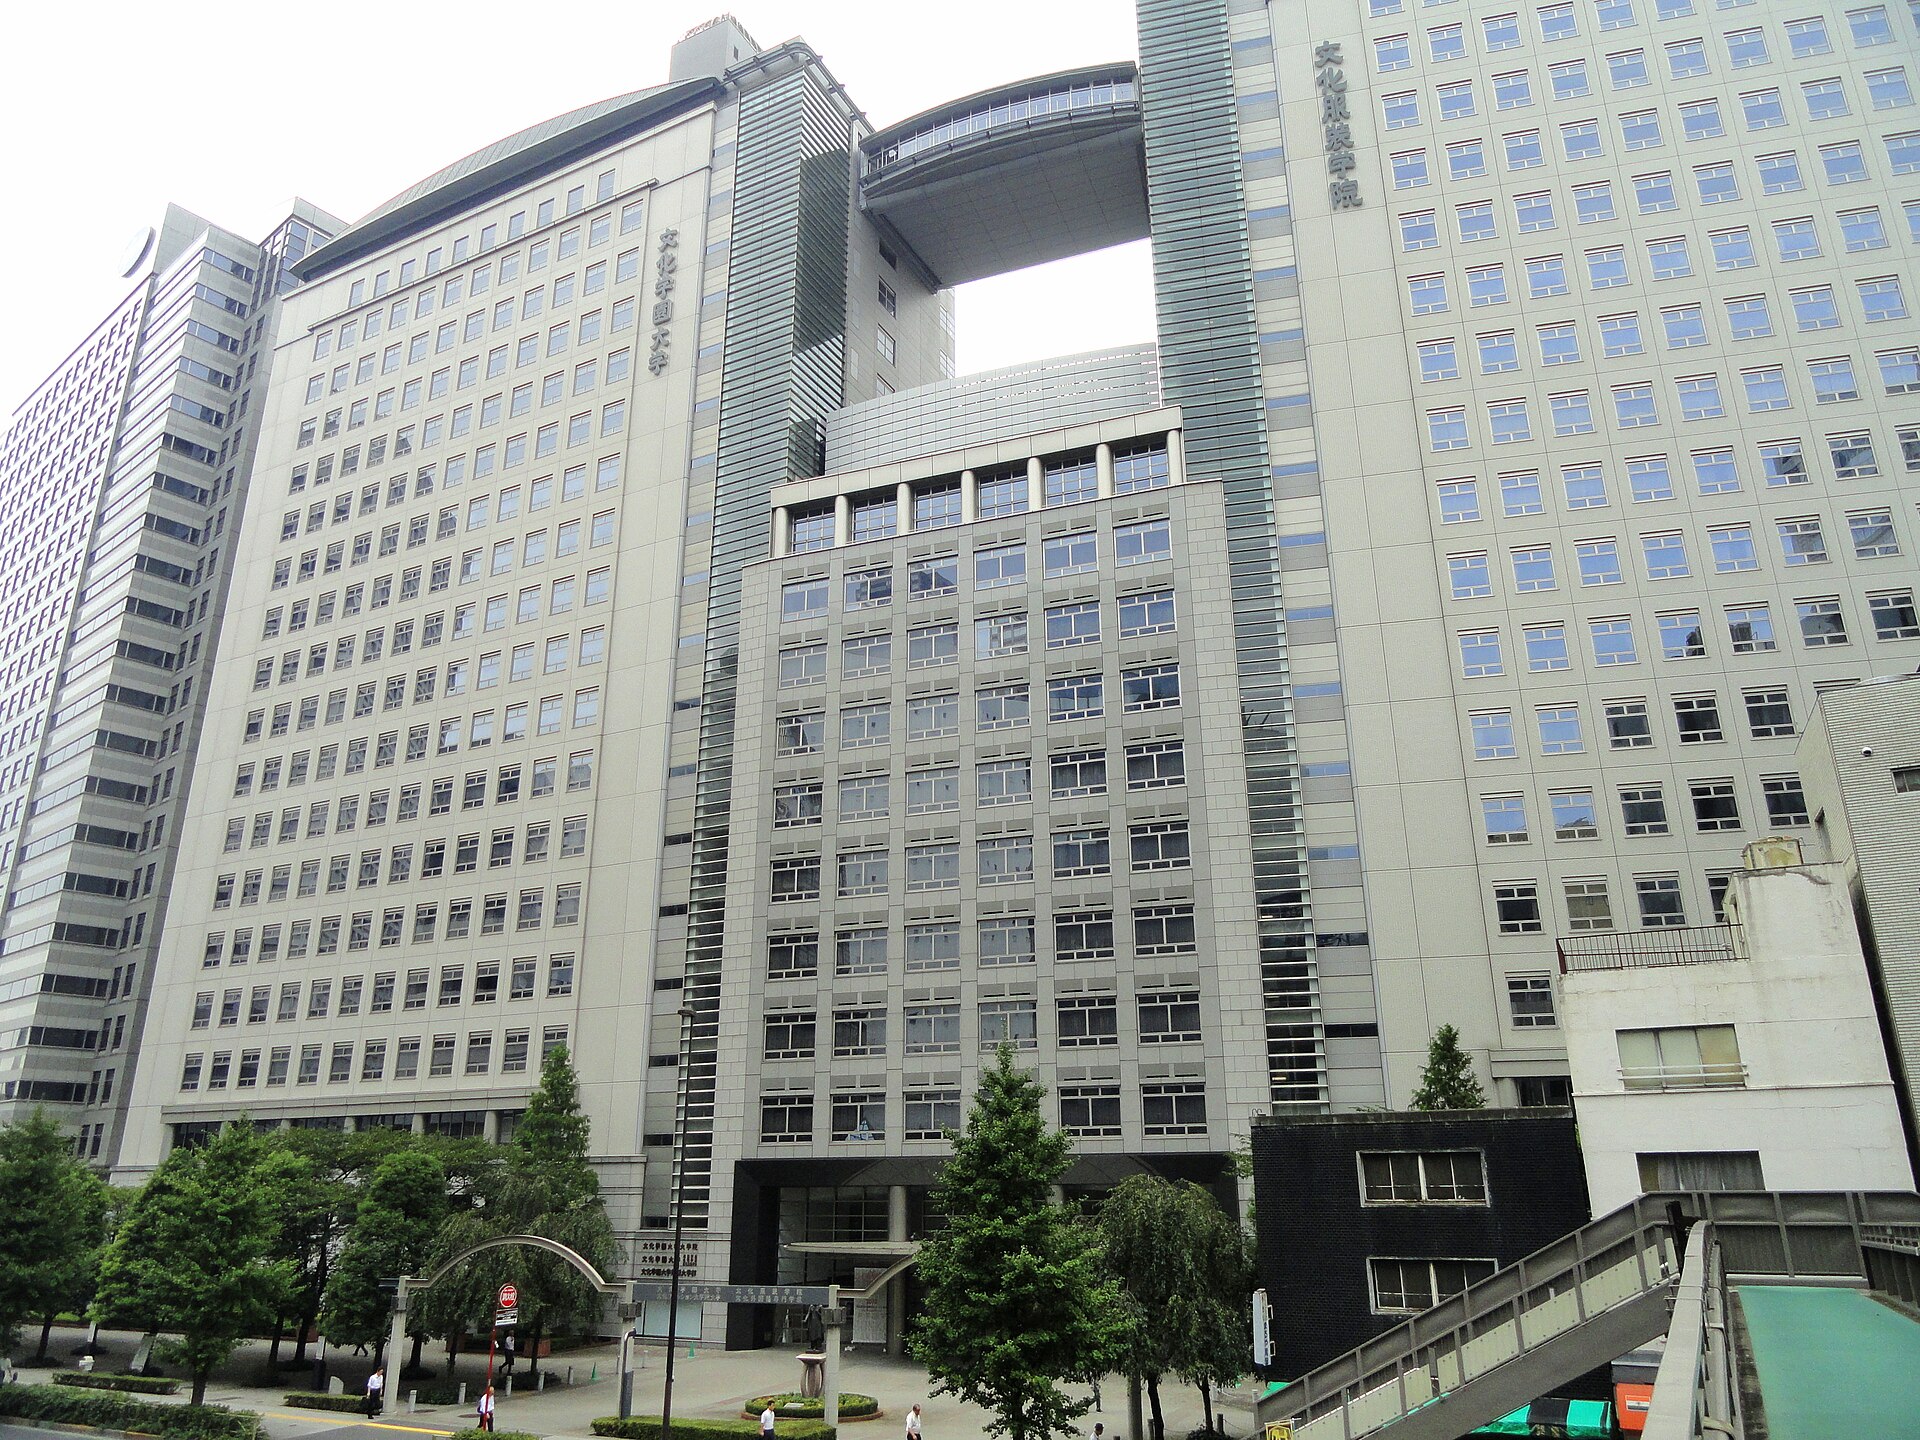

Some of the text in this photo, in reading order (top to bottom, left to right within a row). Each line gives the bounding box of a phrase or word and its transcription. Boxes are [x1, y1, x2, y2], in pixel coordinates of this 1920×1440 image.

[1315, 40, 1363, 210] 文化服装学院
[648, 228, 678, 376] 文化学園大学
[642, 1242, 698, 1251] 文化学園大大学院
